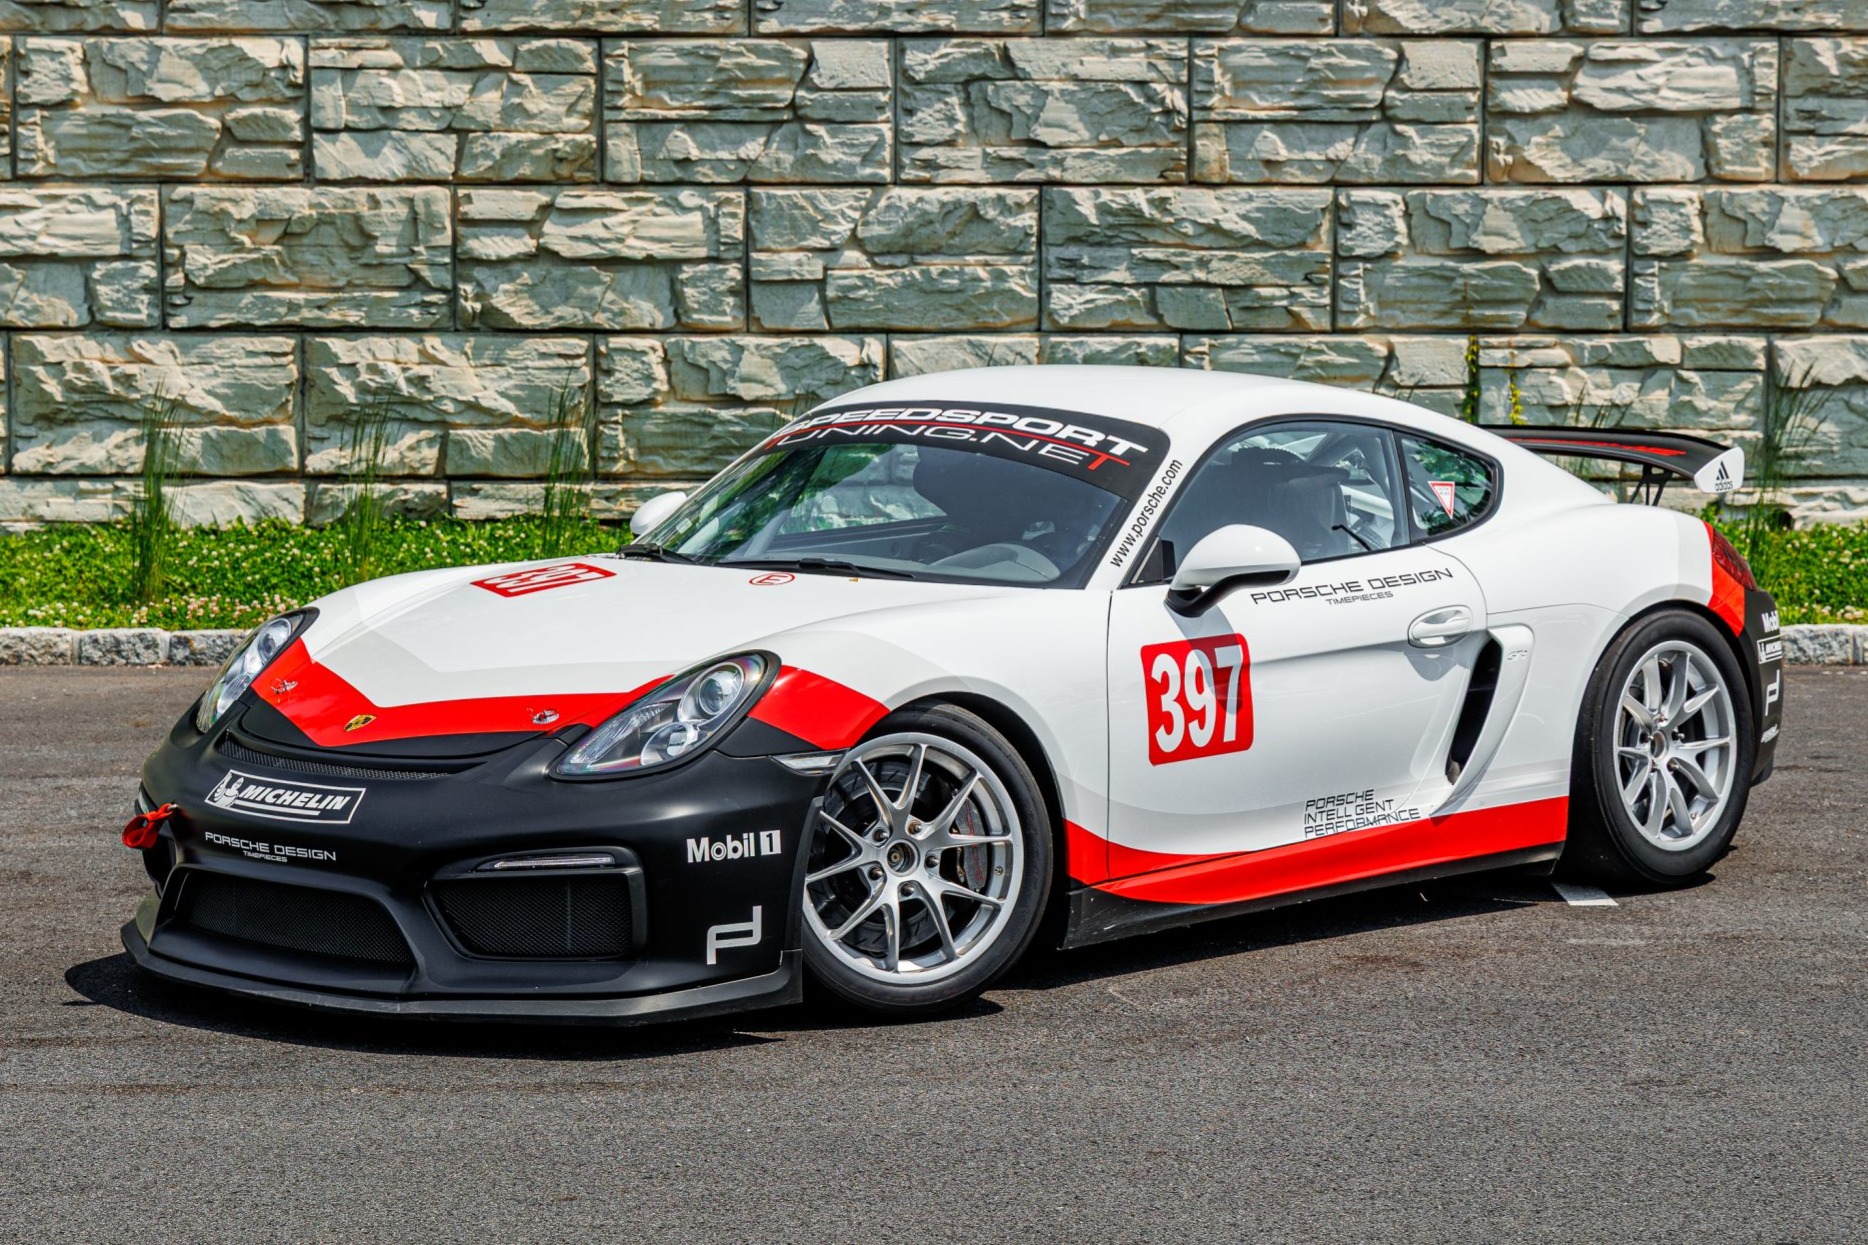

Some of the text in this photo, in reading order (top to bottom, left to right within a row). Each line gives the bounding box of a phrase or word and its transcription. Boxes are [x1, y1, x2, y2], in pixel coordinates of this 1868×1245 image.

[777, 408, 1149, 456] SPEEDSPORT
[1110, 459, 1183, 568] www.porsche.com
[483, 565, 606, 593] 397
[1250, 567, 1454, 605] PORSCHE DESIGN
[1325, 591, 1394, 606] TIMEPIECES
[1151, 644, 1244, 753] 397
[239, 785, 352, 811] MICHELIN
[1305, 789, 1375, 812] PORSCHE
[205, 831, 337, 861] PORSCHE DESIGN
[243, 850, 288, 863] TIMEPIECES
[686, 832, 756, 863] Mobil
